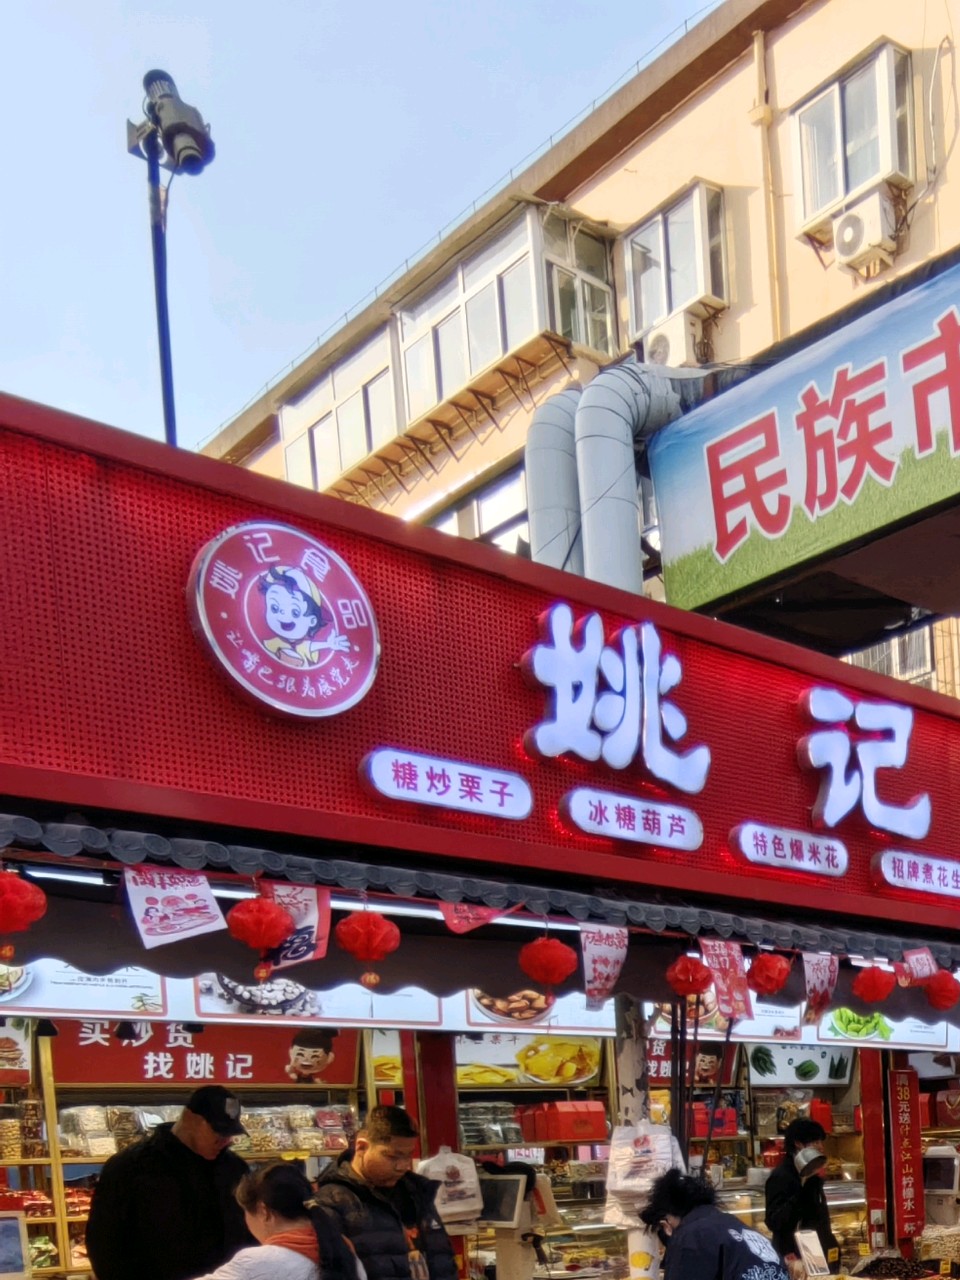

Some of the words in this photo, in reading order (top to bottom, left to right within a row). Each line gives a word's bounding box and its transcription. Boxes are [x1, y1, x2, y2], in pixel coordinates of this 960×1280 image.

[391, 758, 514, 808] 糖炒栗子
[588, 800, 687, 838] 冰糖葫芦
[752, 830, 839, 869] 特色爆米花
[143, 1052, 254, 1079] 找姚记
